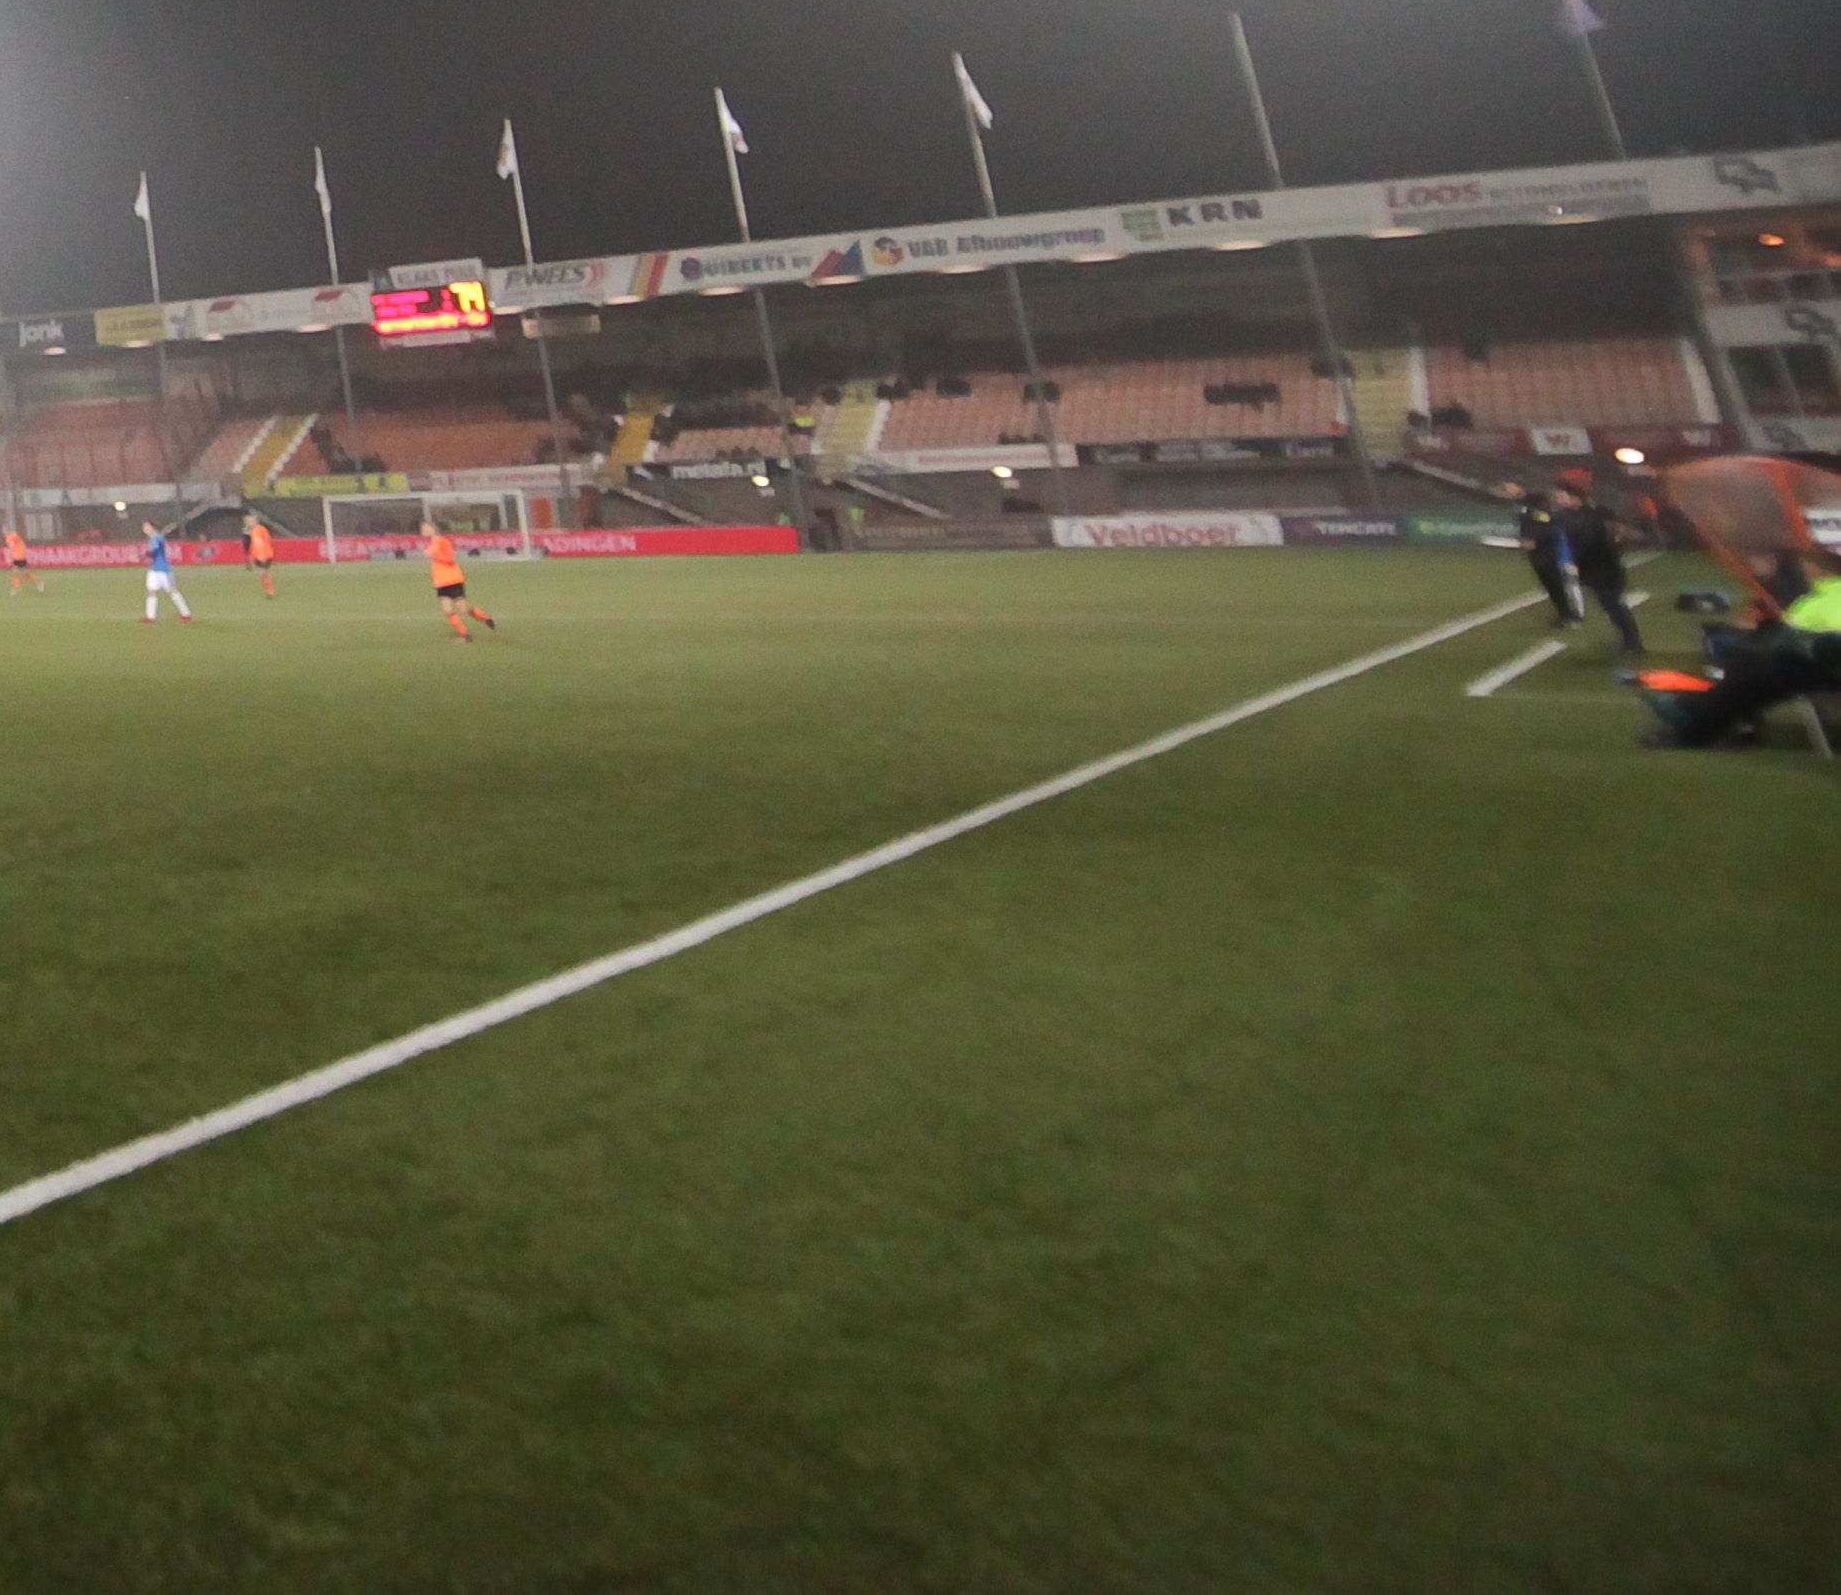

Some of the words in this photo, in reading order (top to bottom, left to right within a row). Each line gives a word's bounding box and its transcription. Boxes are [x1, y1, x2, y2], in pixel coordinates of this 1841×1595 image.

[1387, 181, 1481, 209] LOOS
[1167, 199, 1262, 227] KRN
[19, 320, 63, 348] jonk
[544, 535, 636, 554] ADINGEN
[1084, 520, 1243, 548] Veldboer
